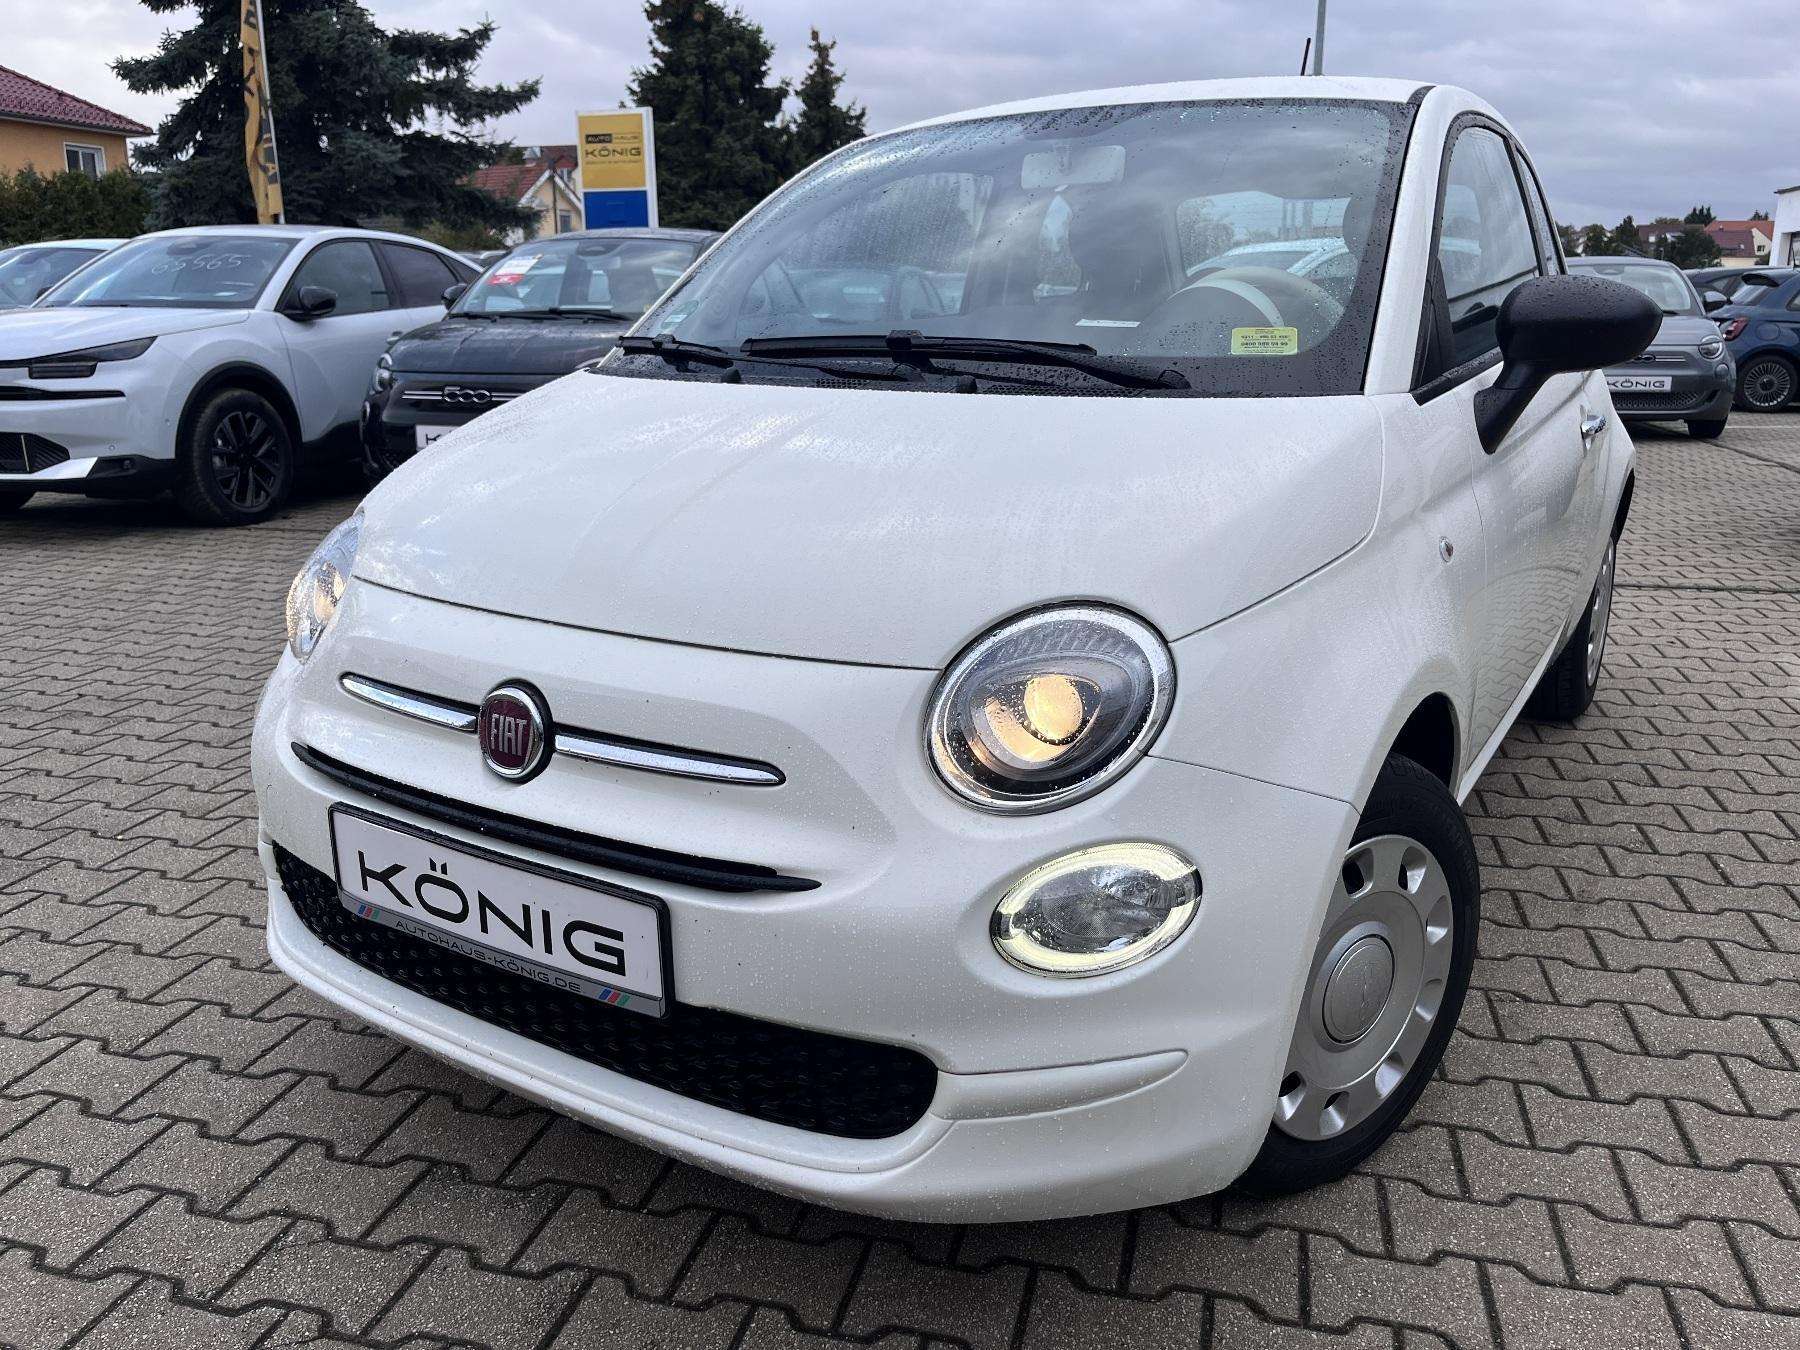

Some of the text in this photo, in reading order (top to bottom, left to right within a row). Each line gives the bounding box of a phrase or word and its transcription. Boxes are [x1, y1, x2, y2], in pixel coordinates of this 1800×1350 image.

[585, 146, 641, 158] KÖNIG
[443, 385, 491, 403] 500
[1607, 378, 1665, 389] KÖNIG
[490, 713, 527, 757] FIAT
[358, 850, 626, 976] KÖNIG
[395, 919, 582, 993] AUTOHAUS-KÖNIG.DE
